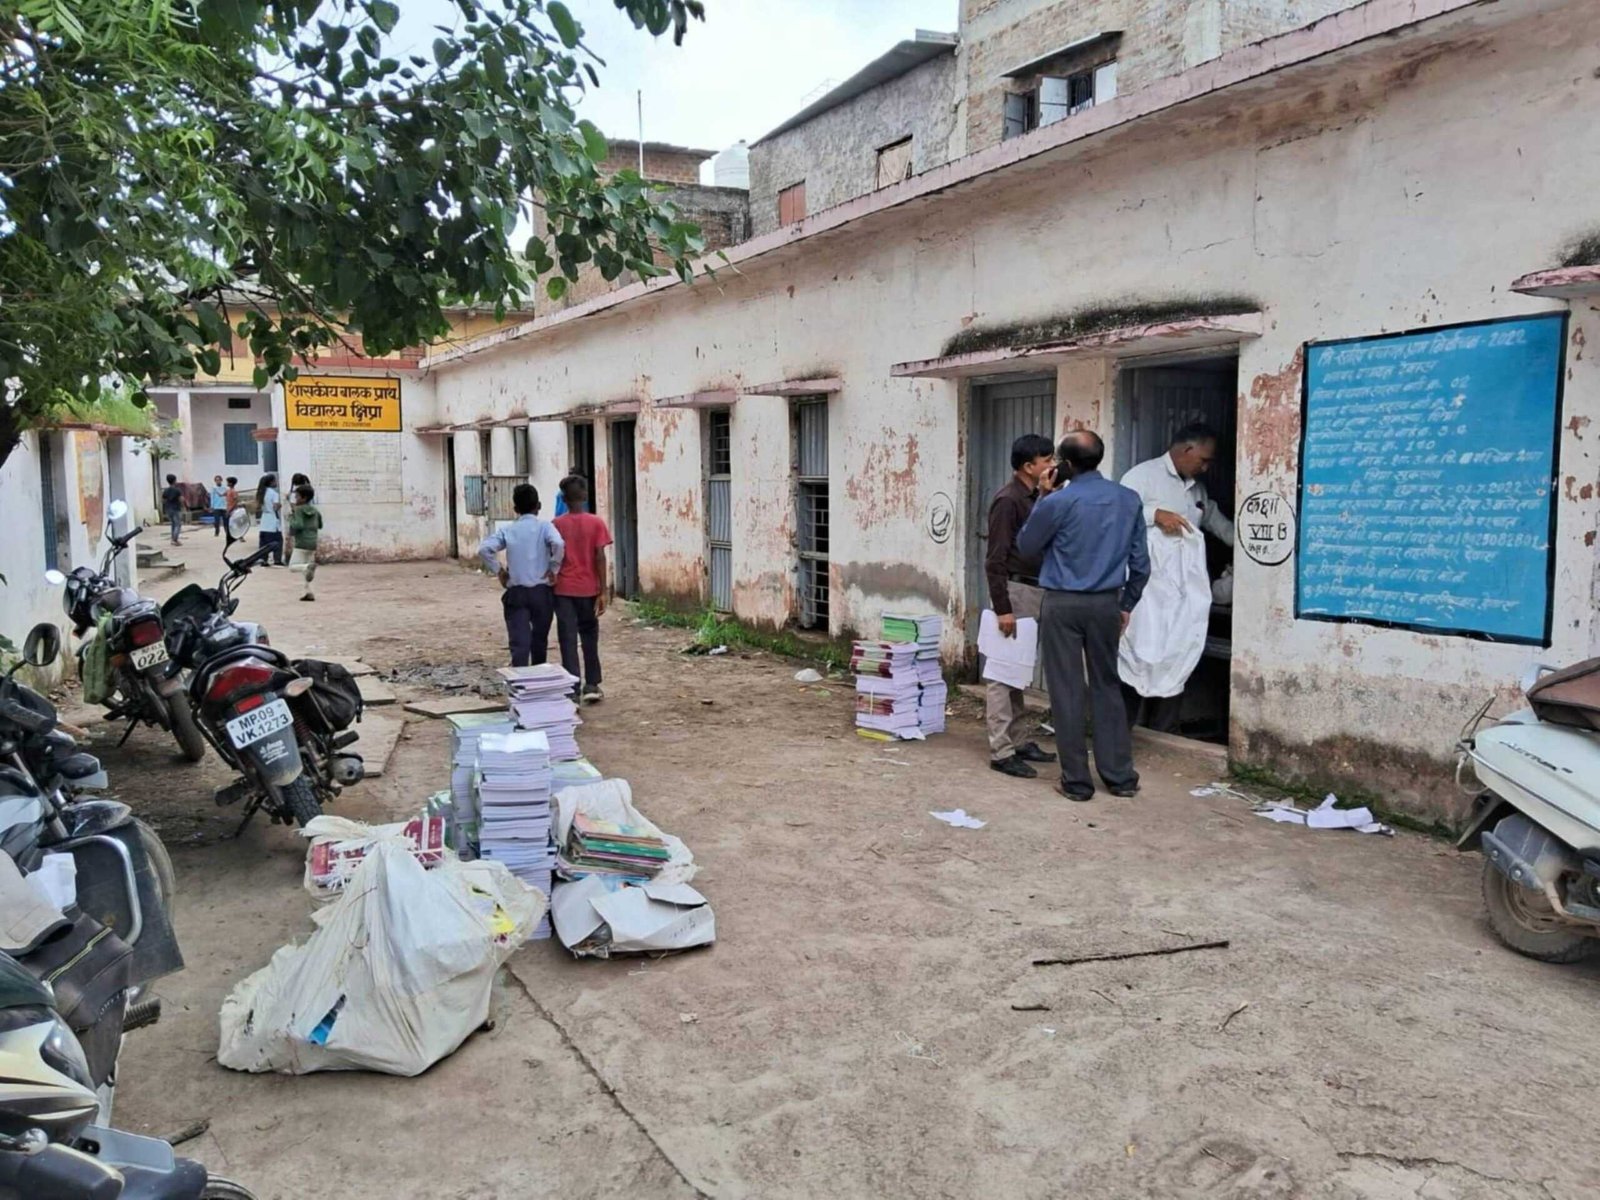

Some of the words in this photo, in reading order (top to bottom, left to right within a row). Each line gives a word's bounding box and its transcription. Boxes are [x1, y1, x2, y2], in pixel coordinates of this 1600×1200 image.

[1488, 327, 1526, 347] 2022
[288, 381, 338, 400] शासकीय
[340, 386, 372, 399] बालक
[296, 400, 348, 417] विद्यालय
[351, 400, 383, 422] क्षिप्रा
[235, 713, 289, 744] VK.1273
[238, 706, 275, 730] MP.09
